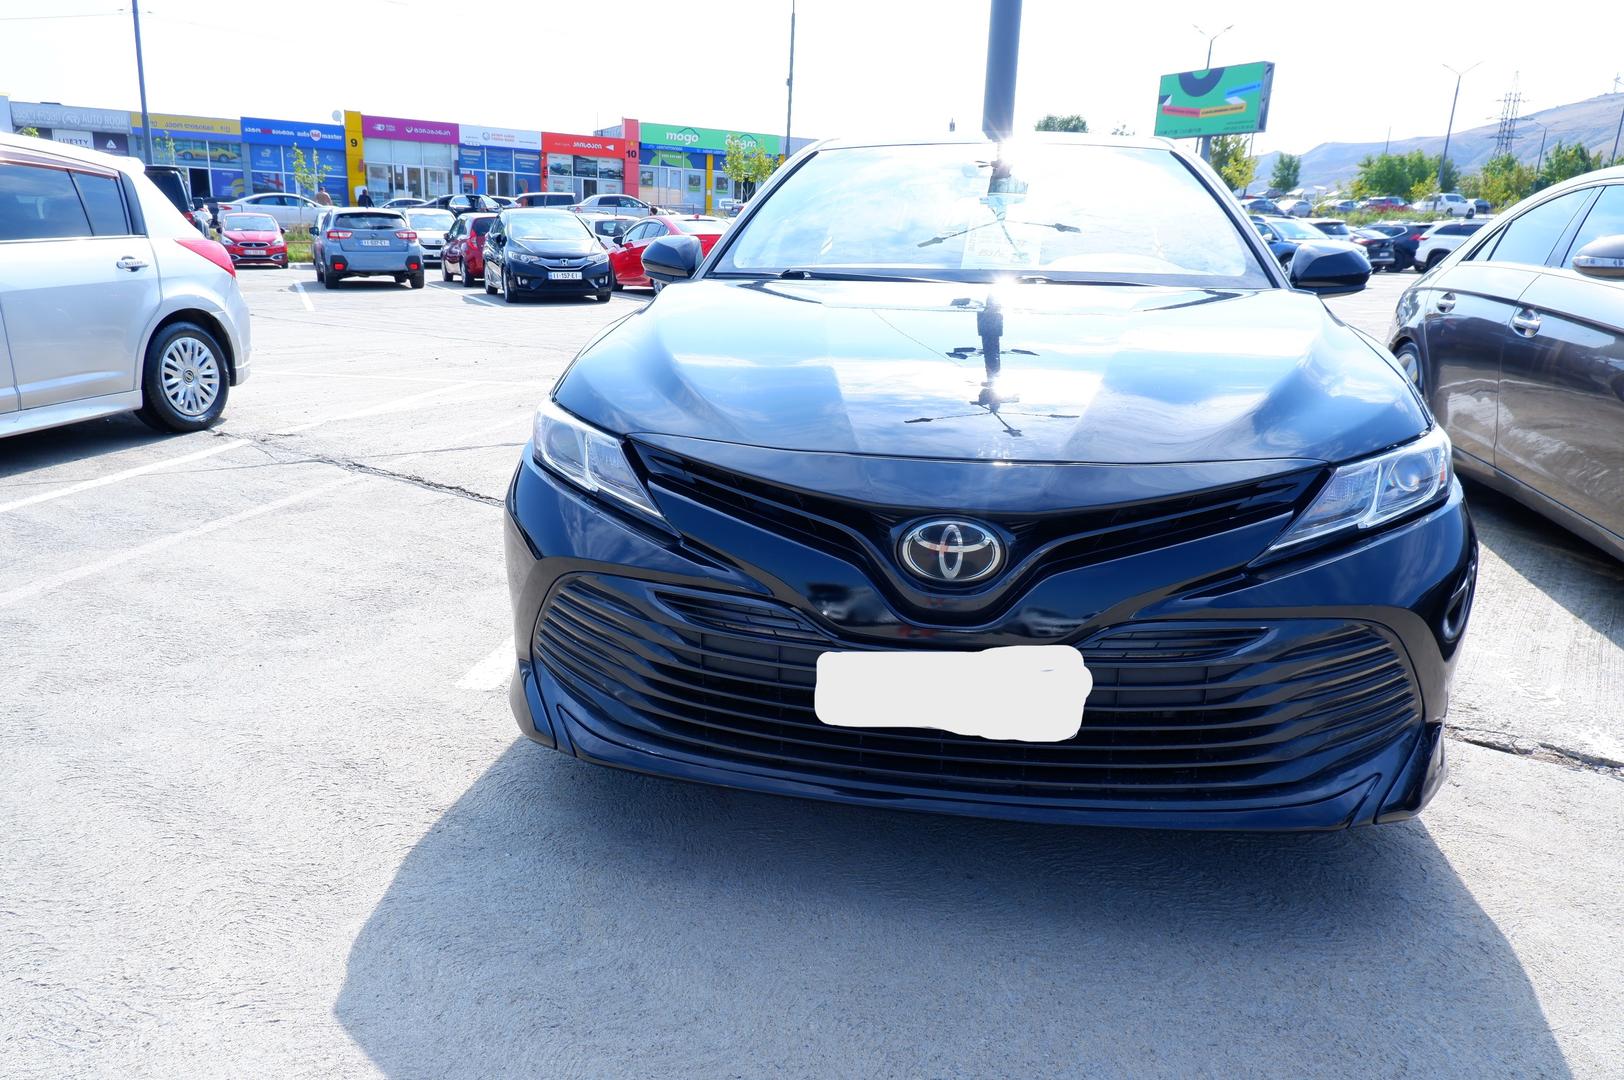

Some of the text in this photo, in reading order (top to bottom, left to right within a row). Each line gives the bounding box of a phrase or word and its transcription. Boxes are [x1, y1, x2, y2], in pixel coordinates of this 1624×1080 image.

[82, 112, 103, 124] AUTO
[350, 138, 358, 147] 9
[665, 130, 699, 145] mogo
[626, 150, 637, 158] 10
